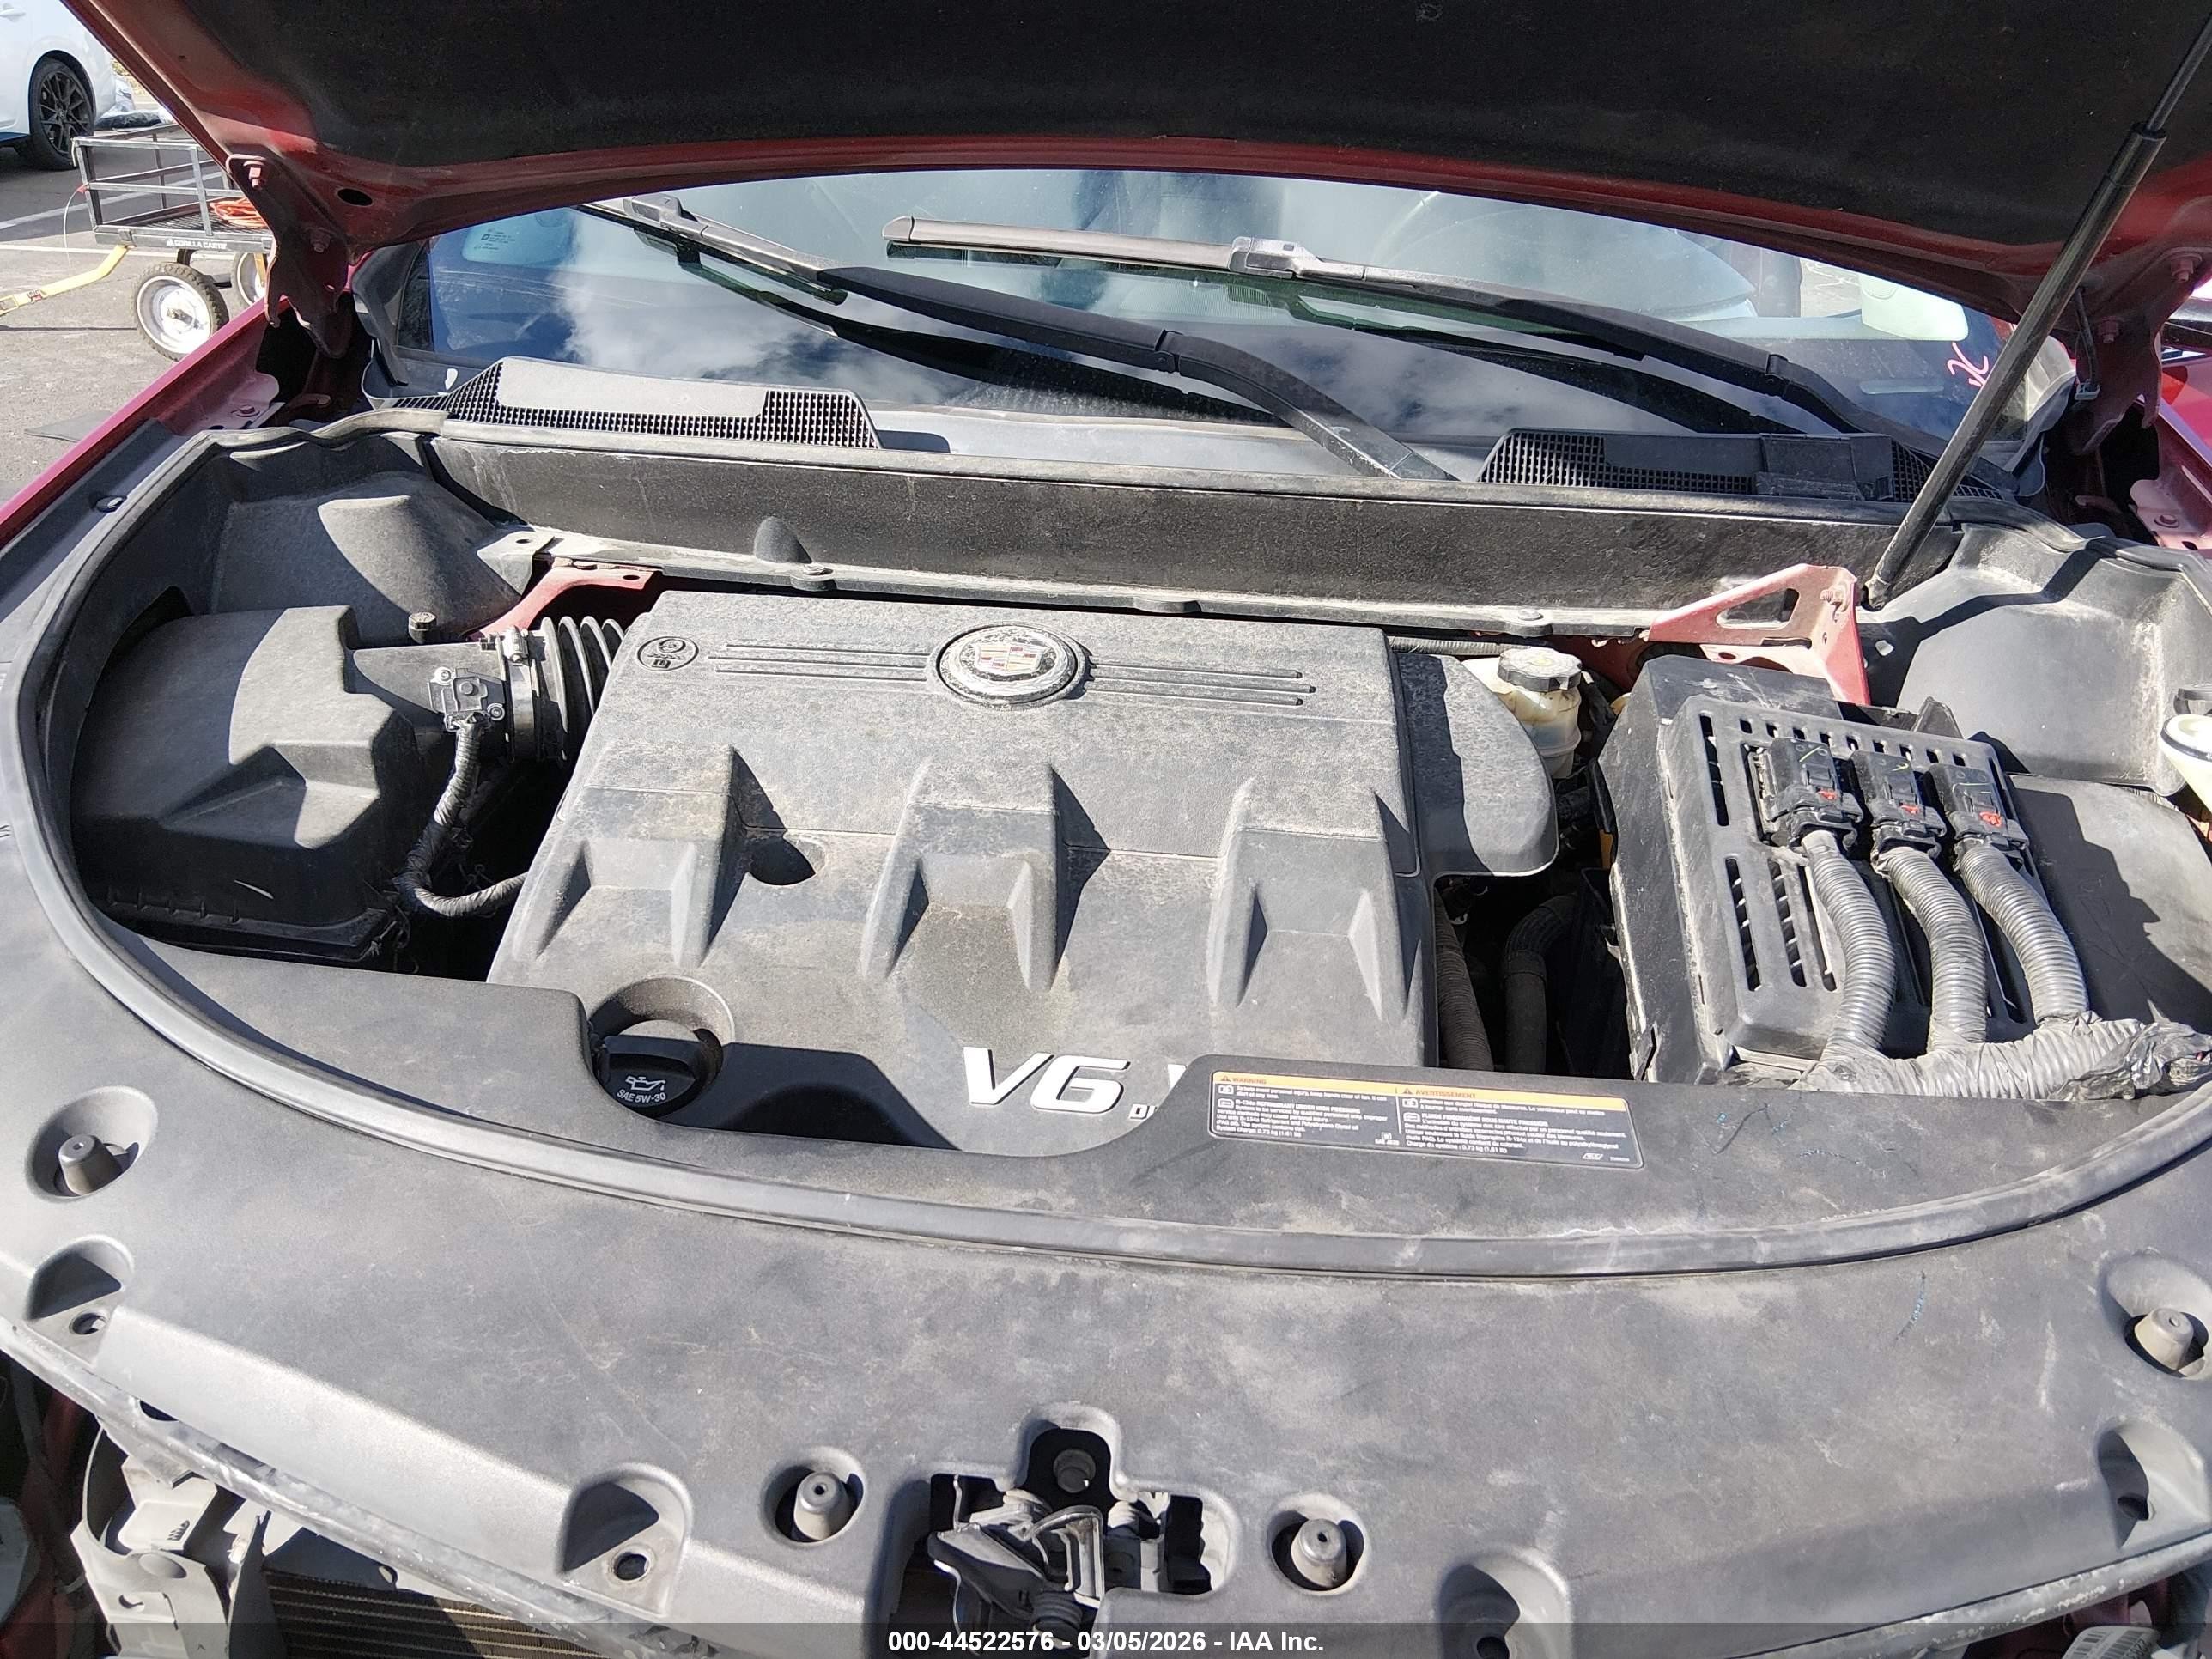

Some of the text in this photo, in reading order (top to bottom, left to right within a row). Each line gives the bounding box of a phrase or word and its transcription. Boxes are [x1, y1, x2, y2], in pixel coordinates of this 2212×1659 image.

[963, 1046, 1131, 1115] V6
[617, 1089, 666, 1103] SAE 5W-30
[1415, 1090, 1475, 1099] AVERTISSEMENT
